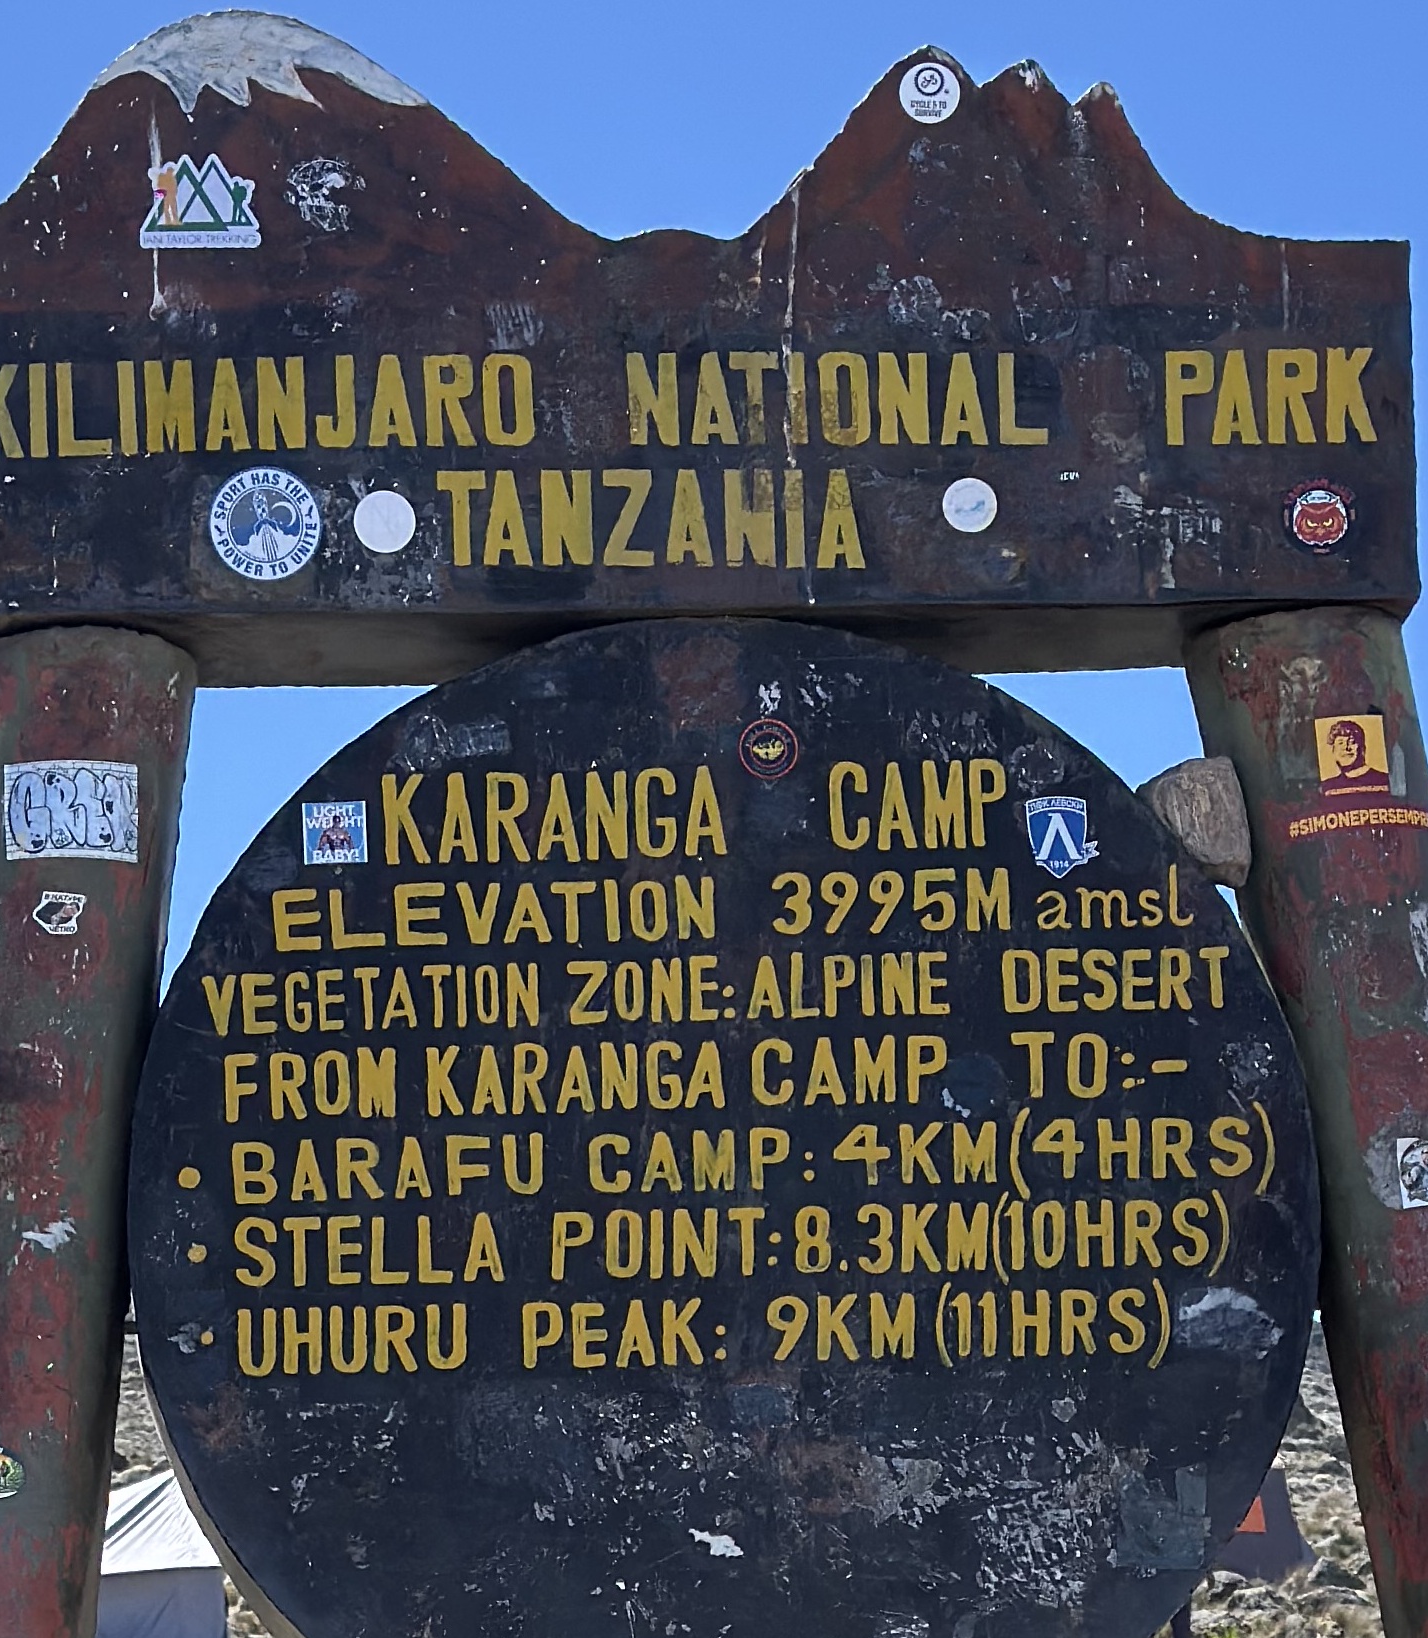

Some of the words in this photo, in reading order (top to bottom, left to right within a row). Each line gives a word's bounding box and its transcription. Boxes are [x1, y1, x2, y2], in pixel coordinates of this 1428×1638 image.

[625, 350, 1050, 448] NATIONAL
[1164, 347, 1378, 446] PARK
[213, 477, 247, 520] SPORT
[250, 472, 281, 486] HAS
[284, 478, 310, 505] THE
[436, 468, 866, 569] TANZANIA
[217, 538, 264, 577] POWER
[268, 561, 289, 577] TO
[290, 522, 318, 565] UNITE
[312, 804, 355, 818] LIGHT
[381, 767, 727, 866] KARANGA
[828, 758, 1007, 852] CAMP
[312, 848, 360, 863] BABY!
[1049, 860, 1070, 869] 1914
[271, 875, 716, 953] ELEVATION
[772, 867, 1012, 937] 3995M
[1036, 864, 1195, 930] amsl
[201, 961, 540, 1037] VEGETATION
[1000, 945, 1231, 1014] DESERT
[223, 1045, 396, 1123] FROM
[425, 1039, 726, 1117] KARANGA
[750, 1033, 949, 1108] CAMP
[230, 1131, 545, 1205] BARAFU
[233, 1211, 507, 1288] STELLA
[236, 1301, 469, 1376] UHURU
[521, 1296, 729, 1370] PEAK:
